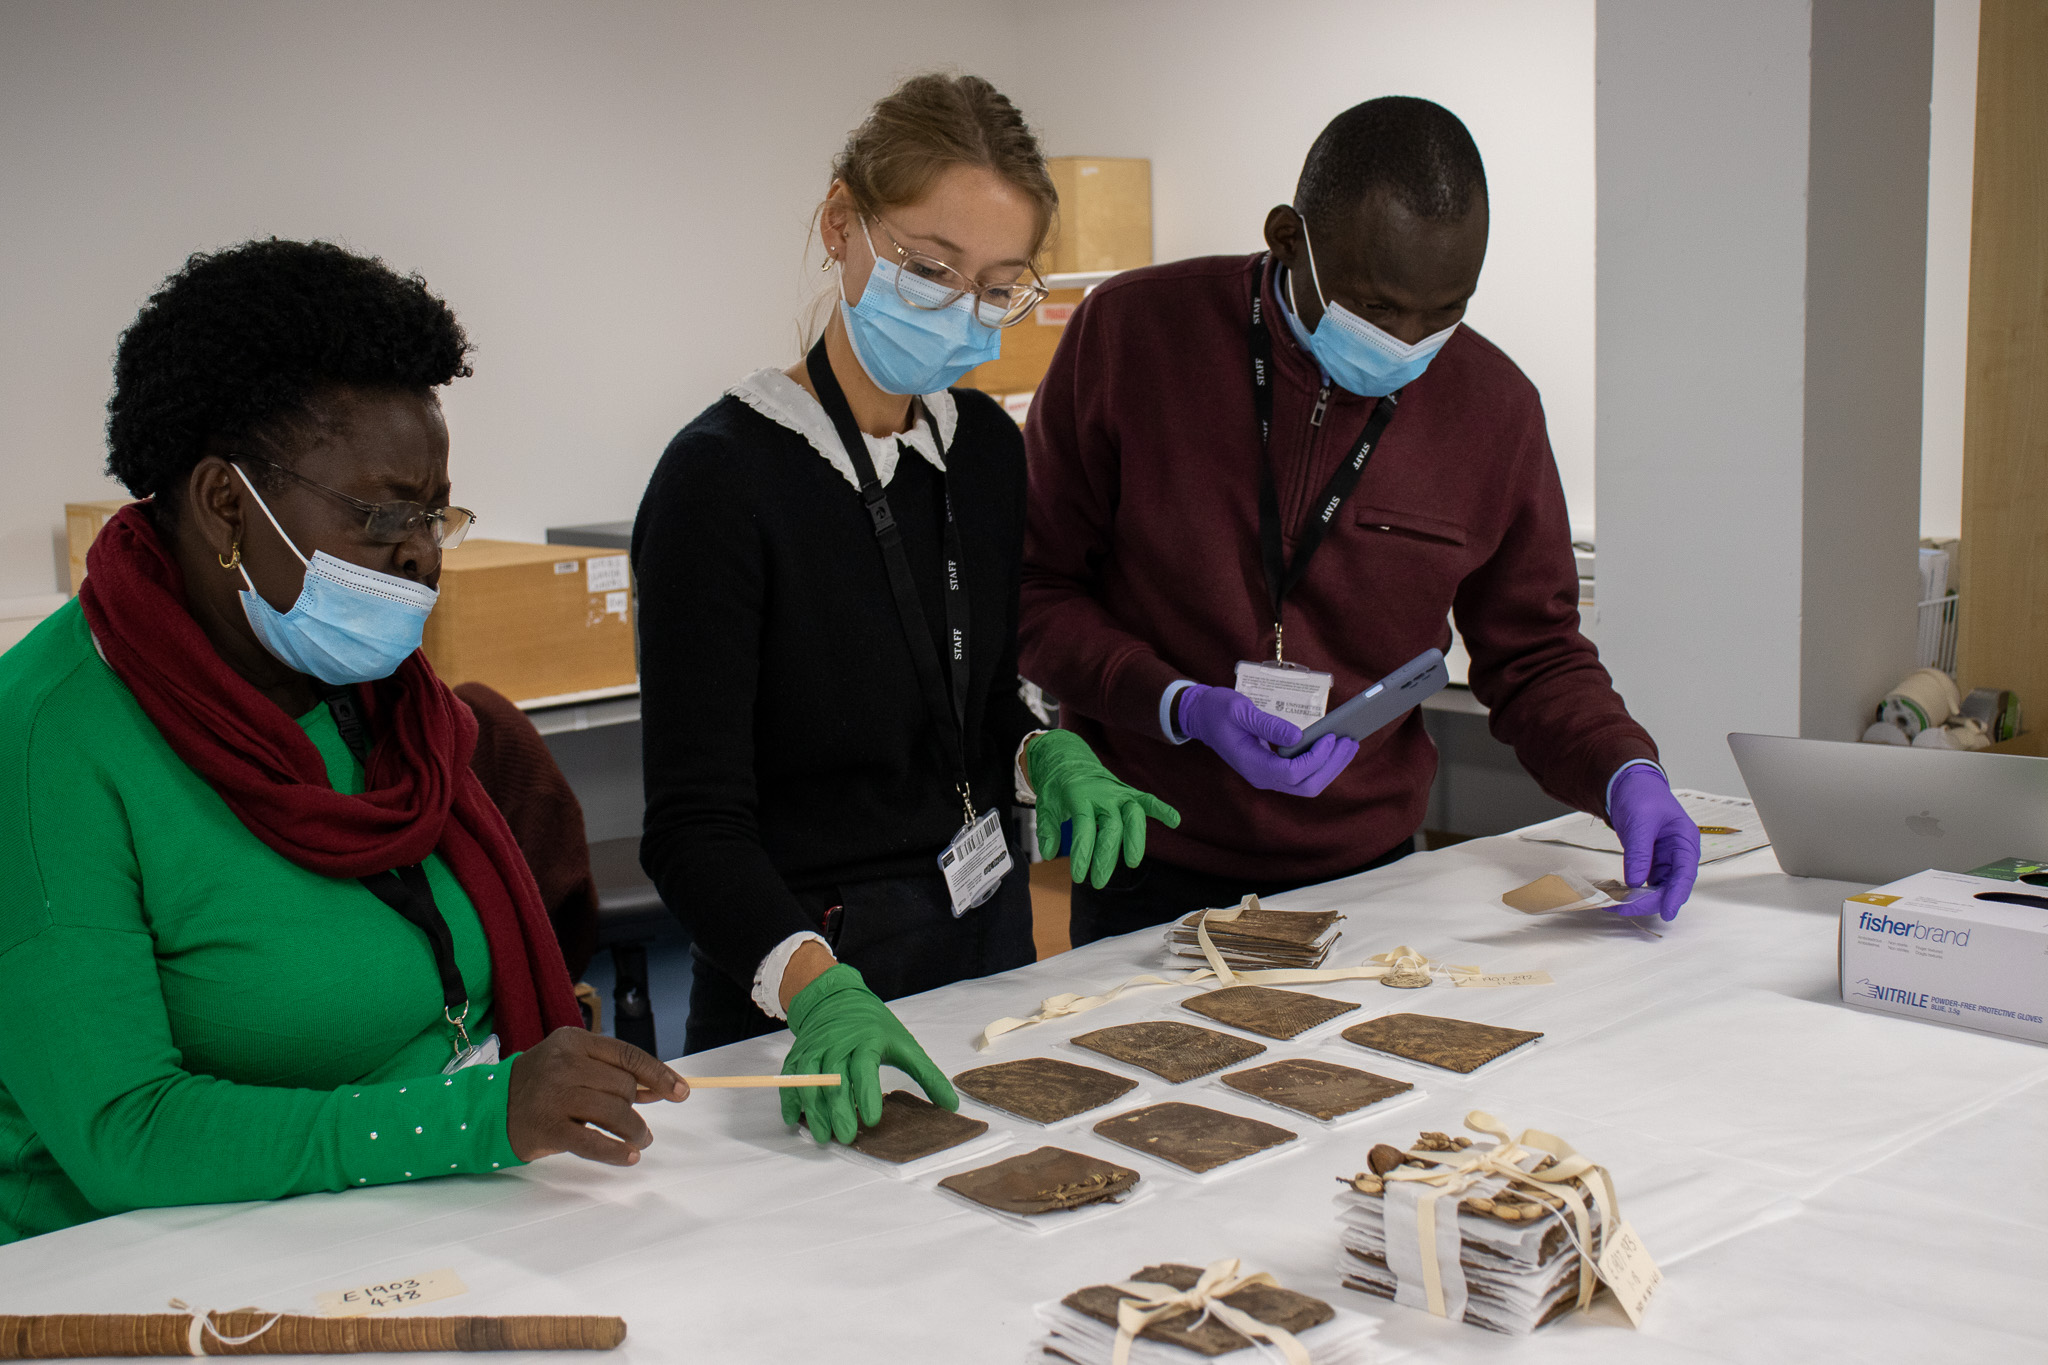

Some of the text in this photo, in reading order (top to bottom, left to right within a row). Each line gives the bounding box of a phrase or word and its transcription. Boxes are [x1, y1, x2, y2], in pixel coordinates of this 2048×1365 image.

[1253, 297, 1261, 325] STAFF
[1255, 358, 1265, 386] STAFF
[1352, 442, 1371, 470] STAFF
[1321, 496, 1340, 523] STAFF
[948, 560, 959, 590] STAFF
[953, 628, 962, 660] STAFF
[1859, 912, 1971, 947] fisherbrand
[1875, 985, 1929, 1009] NITRILE
[1931, 996, 2043, 1024] POWDER-FREE PROTECTIVE GLOVES
[1948, 1007, 1961, 1016] 3.5g
[370, 1290, 421, 1306] 478
